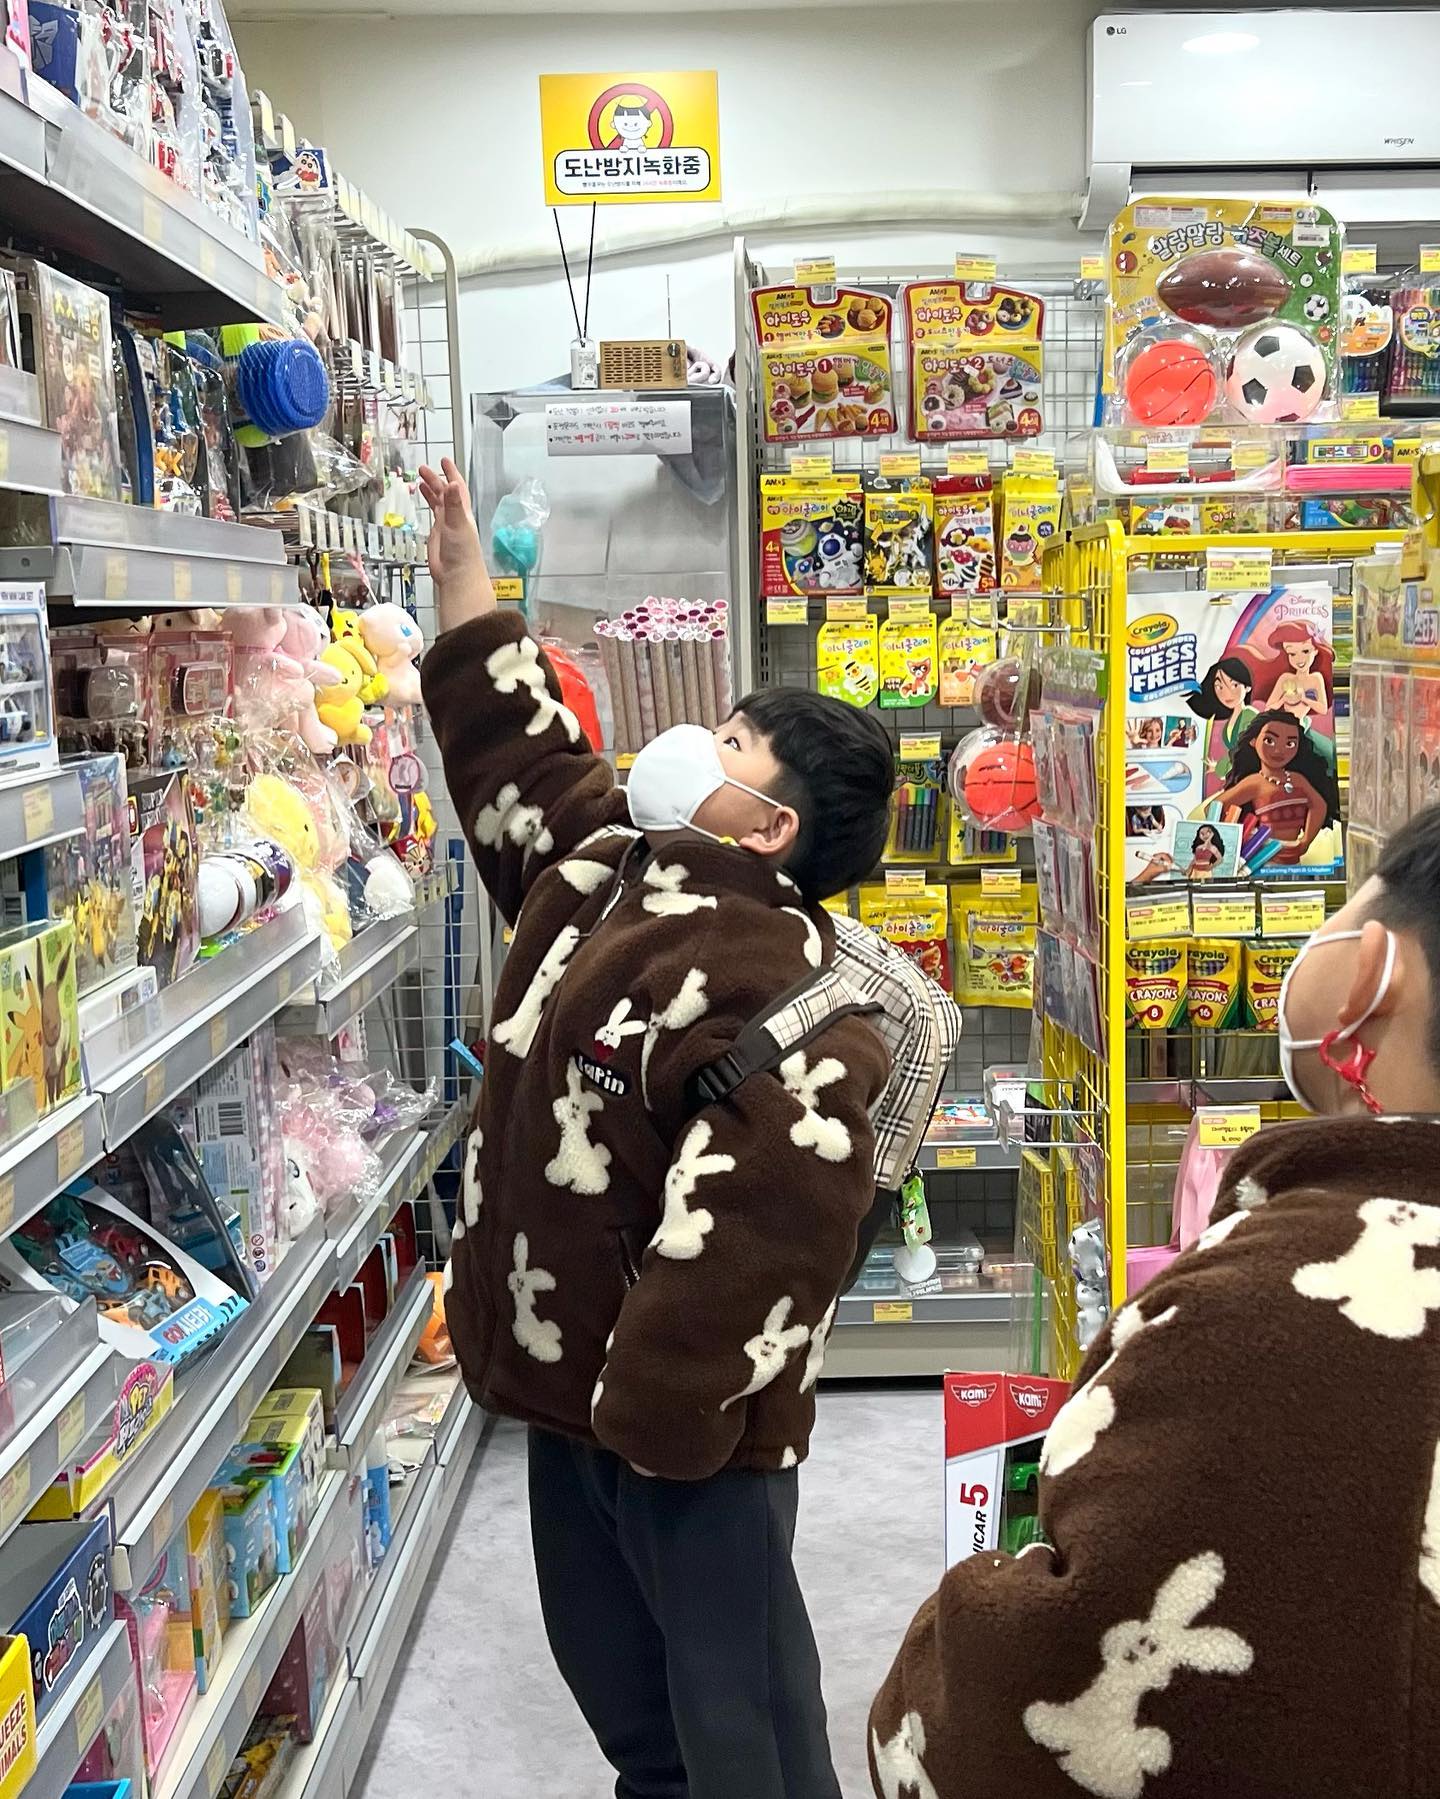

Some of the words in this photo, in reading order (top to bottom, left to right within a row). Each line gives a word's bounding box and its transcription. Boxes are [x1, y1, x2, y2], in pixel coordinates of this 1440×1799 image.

[1116, 27, 1127, 35] LG
[564, 155, 700, 178] 도난방지녹화중
[1151, 222, 1224, 262] 말랑말랑
[1274, 604, 1329, 620] PRINCESS
[1133, 621, 1168, 635] Crayola
[1129, 645, 1158, 656] COLOR
[1131, 643, 1195, 675] MESS
[1133, 661, 1196, 693] FREE
[1129, 947, 1178, 961] Crayola
[1188, 949, 1227, 963] rayola
[1130, 987, 1178, 1002] CRAYONS
[1188, 989, 1228, 1005] RAYONS
[1254, 998, 1280, 1010] CRA
[1199, 1008, 1211, 1018] 16
[960, 1482, 989, 1507] 5
